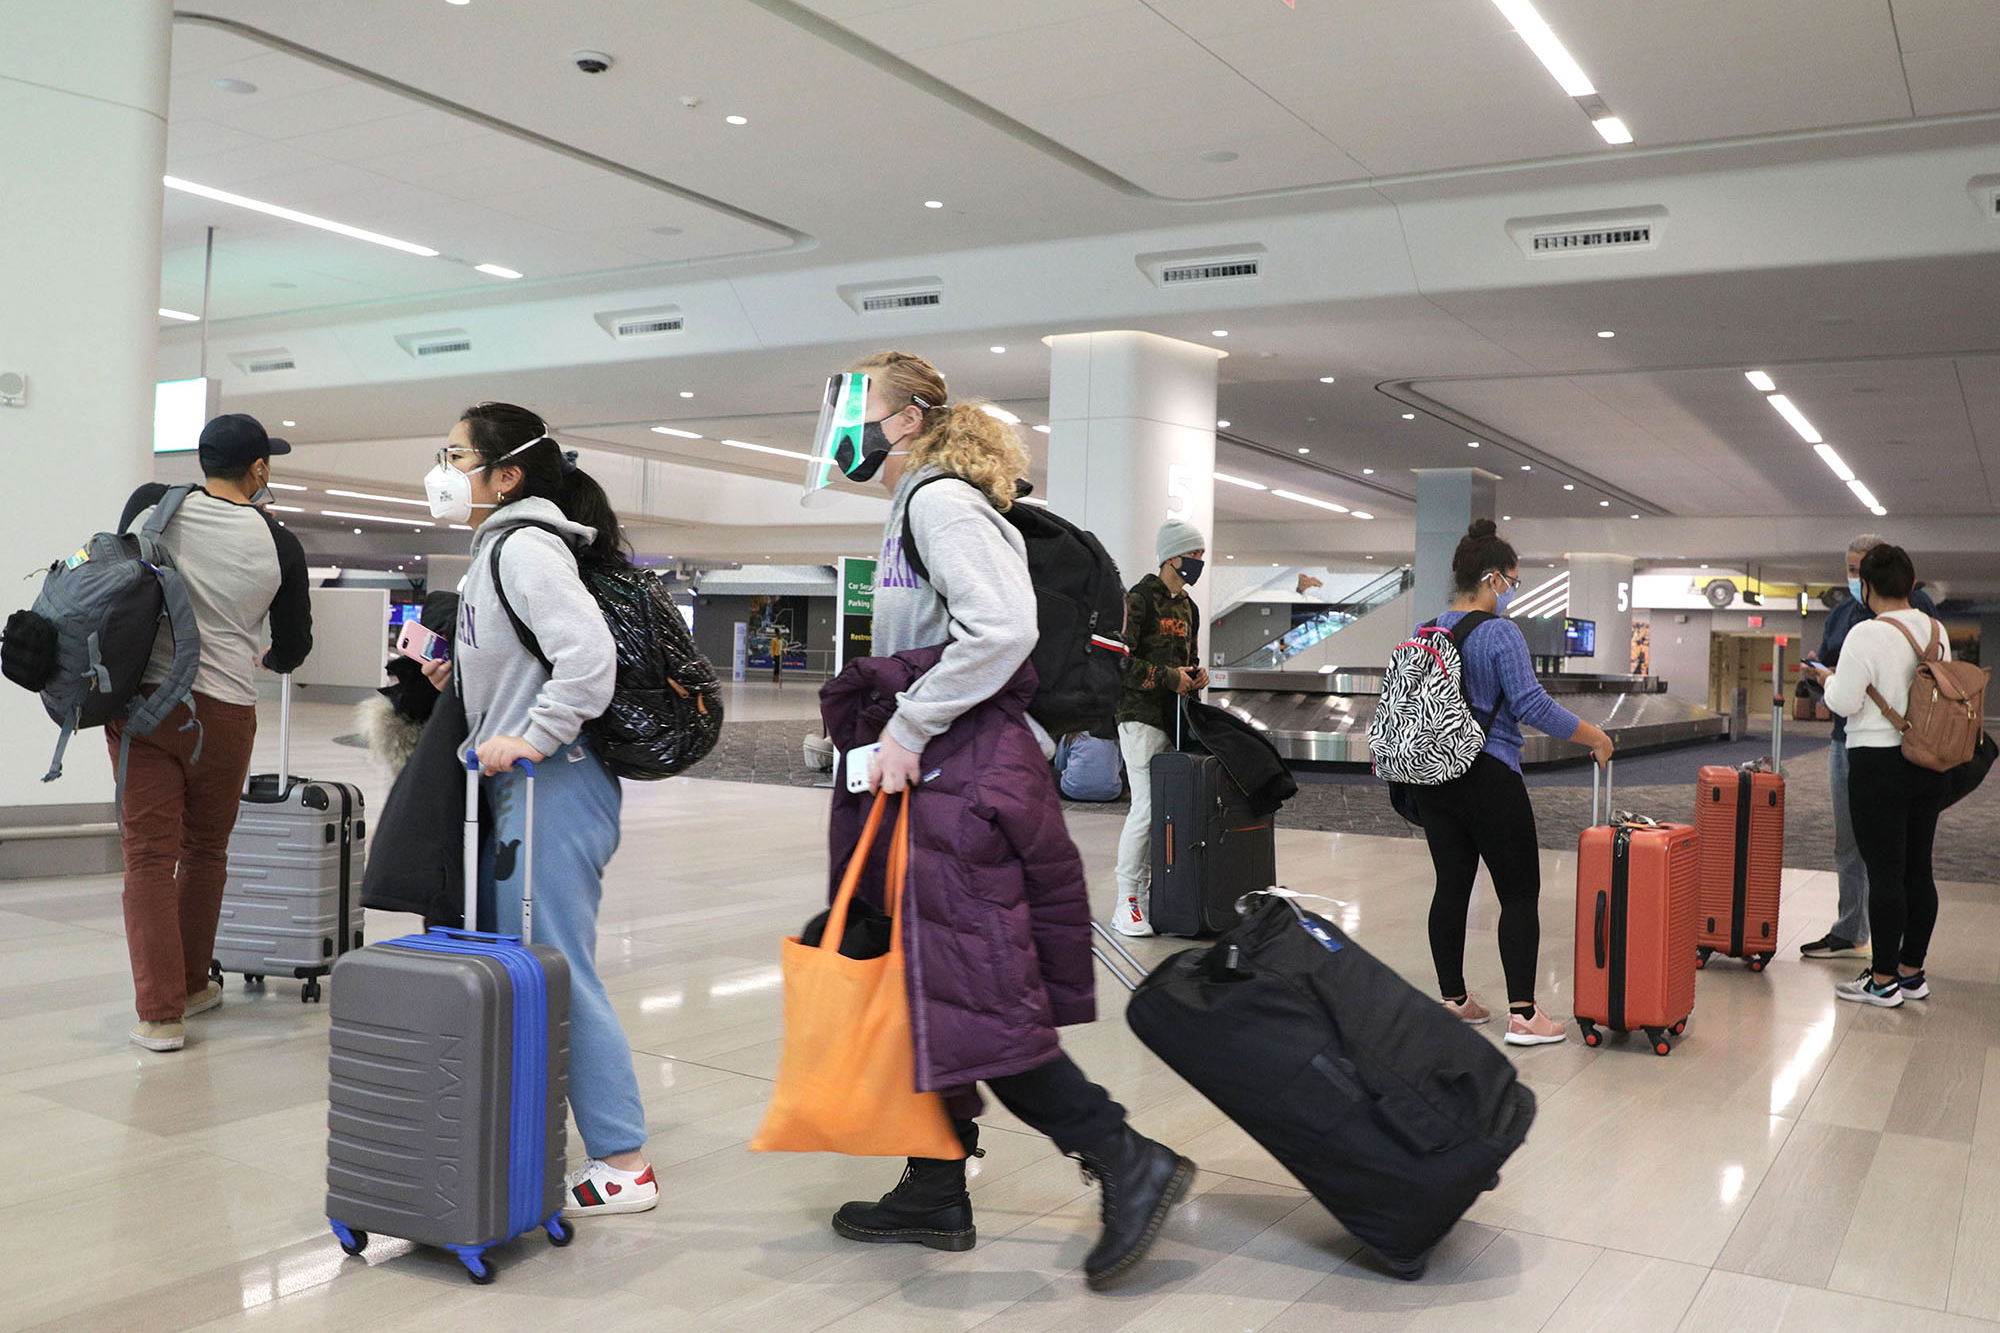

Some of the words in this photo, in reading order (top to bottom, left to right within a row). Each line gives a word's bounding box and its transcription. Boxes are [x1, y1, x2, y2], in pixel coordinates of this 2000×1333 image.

[1167, 464, 1193, 522] 5
[848, 582, 859, 590] Car
[1617, 582, 1629, 612] 5
[848, 599, 870, 609] Parking
[435, 1033, 463, 1219] NAUTICA
